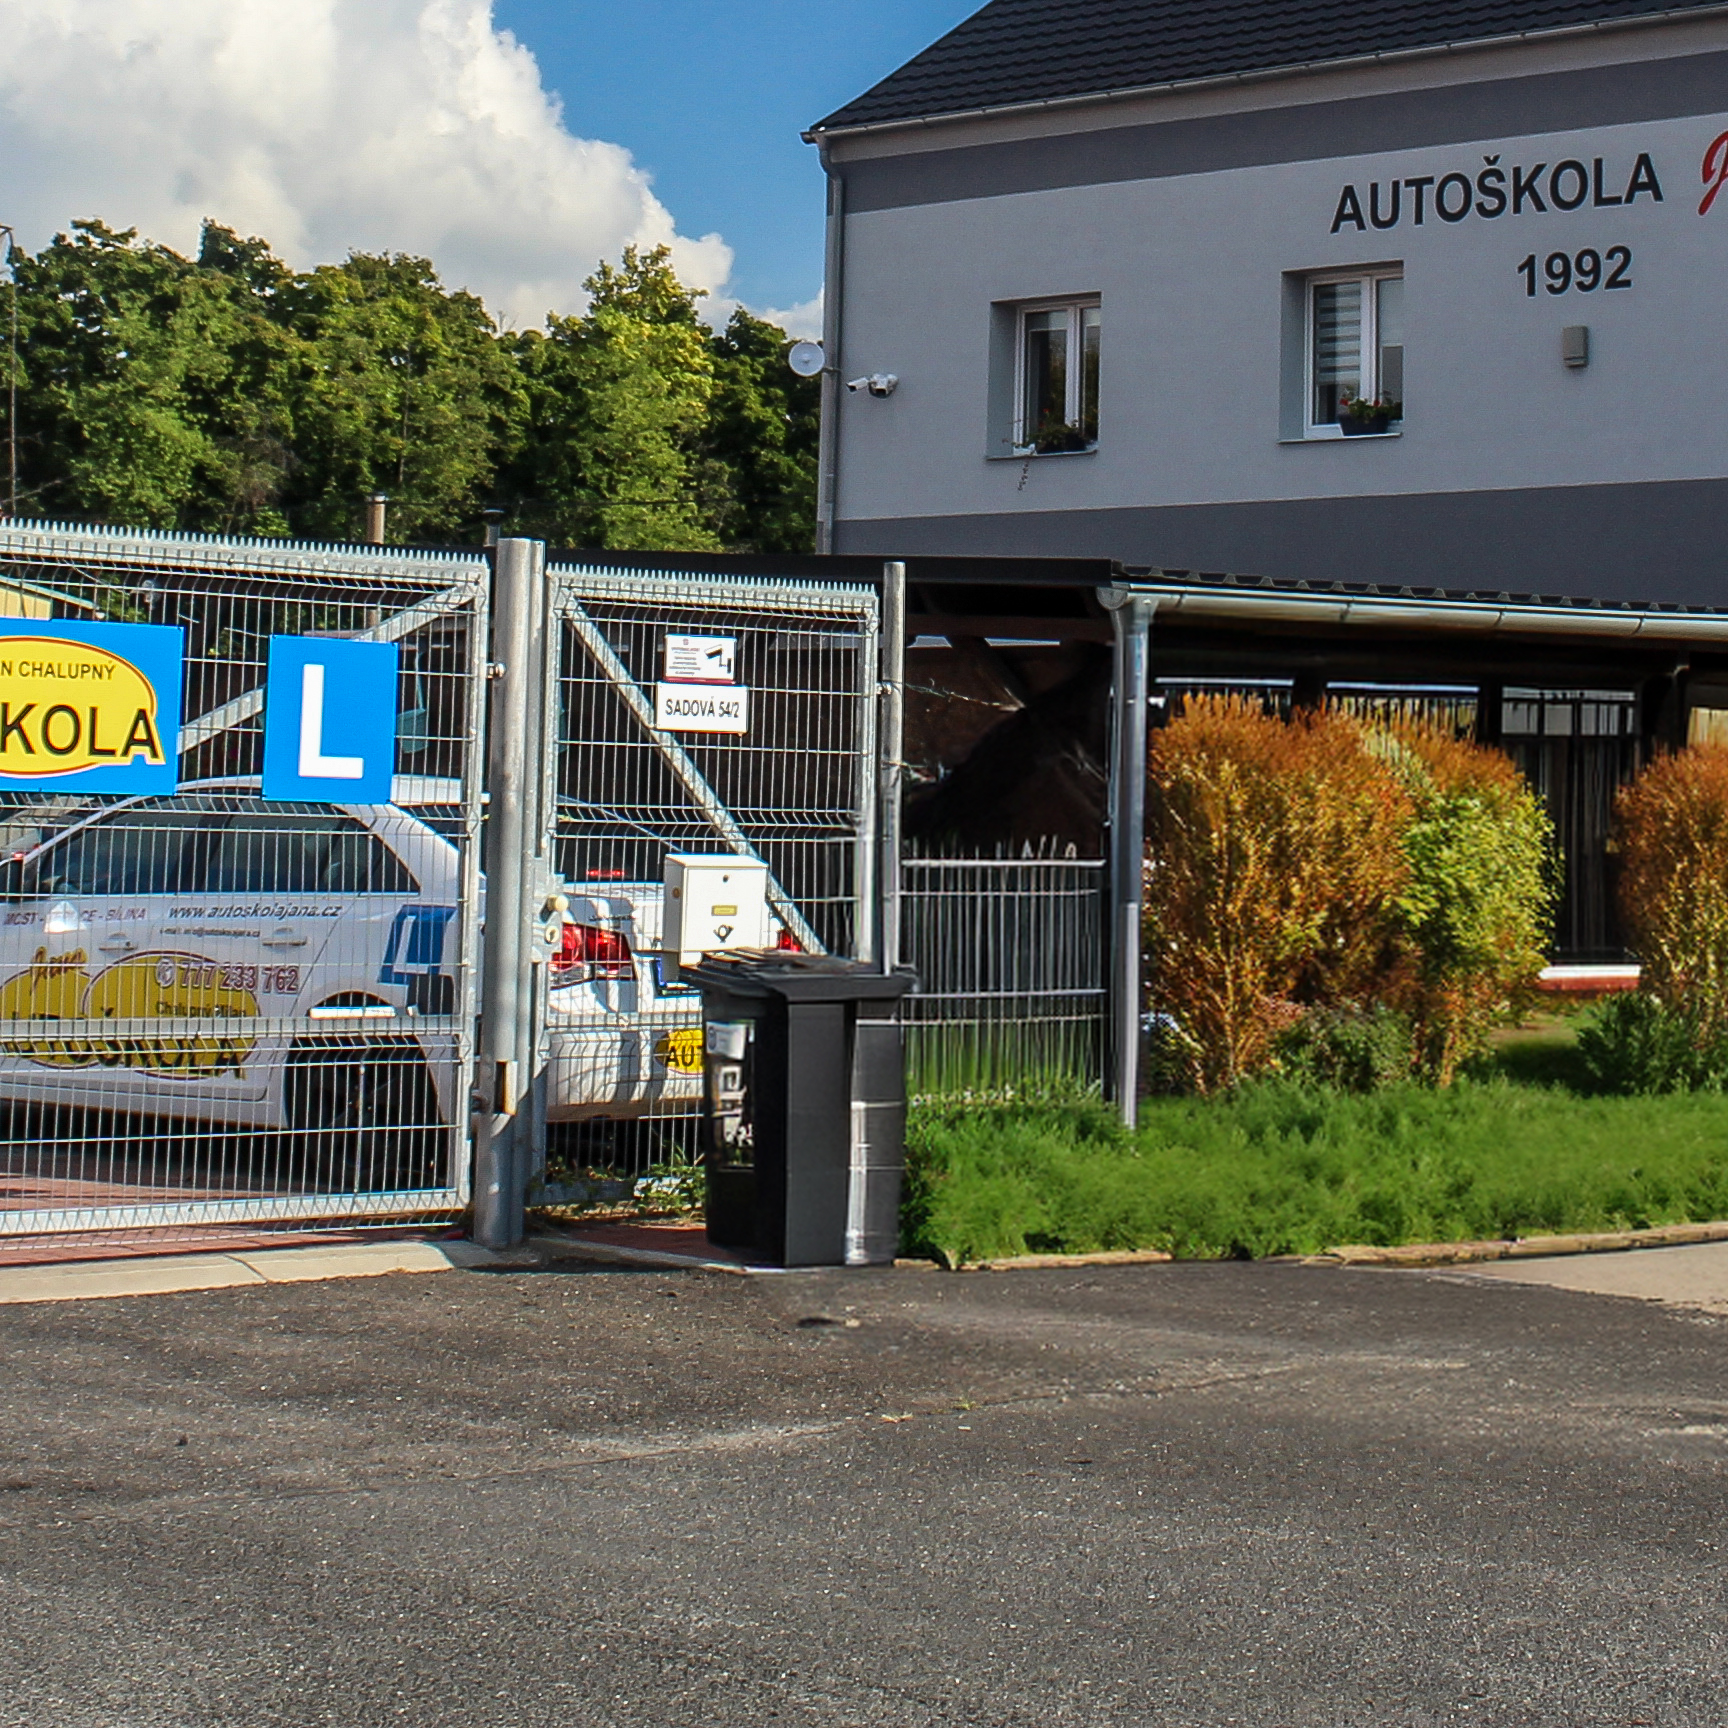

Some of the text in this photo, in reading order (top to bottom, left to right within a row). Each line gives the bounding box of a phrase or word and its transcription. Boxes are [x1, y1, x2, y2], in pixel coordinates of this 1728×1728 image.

[1329, 152, 1665, 234] AUTOŠKOLA
[1517, 245, 1632, 297] 1992
[18, 660, 116, 681] CHALUPNÝ
[298, 663, 364, 779] L
[665, 695, 740, 718] SADOVÁ 54/2
[168, 902, 344, 921] www.autoskolajana.cz
[180, 959, 300, 994] 777 233 762
